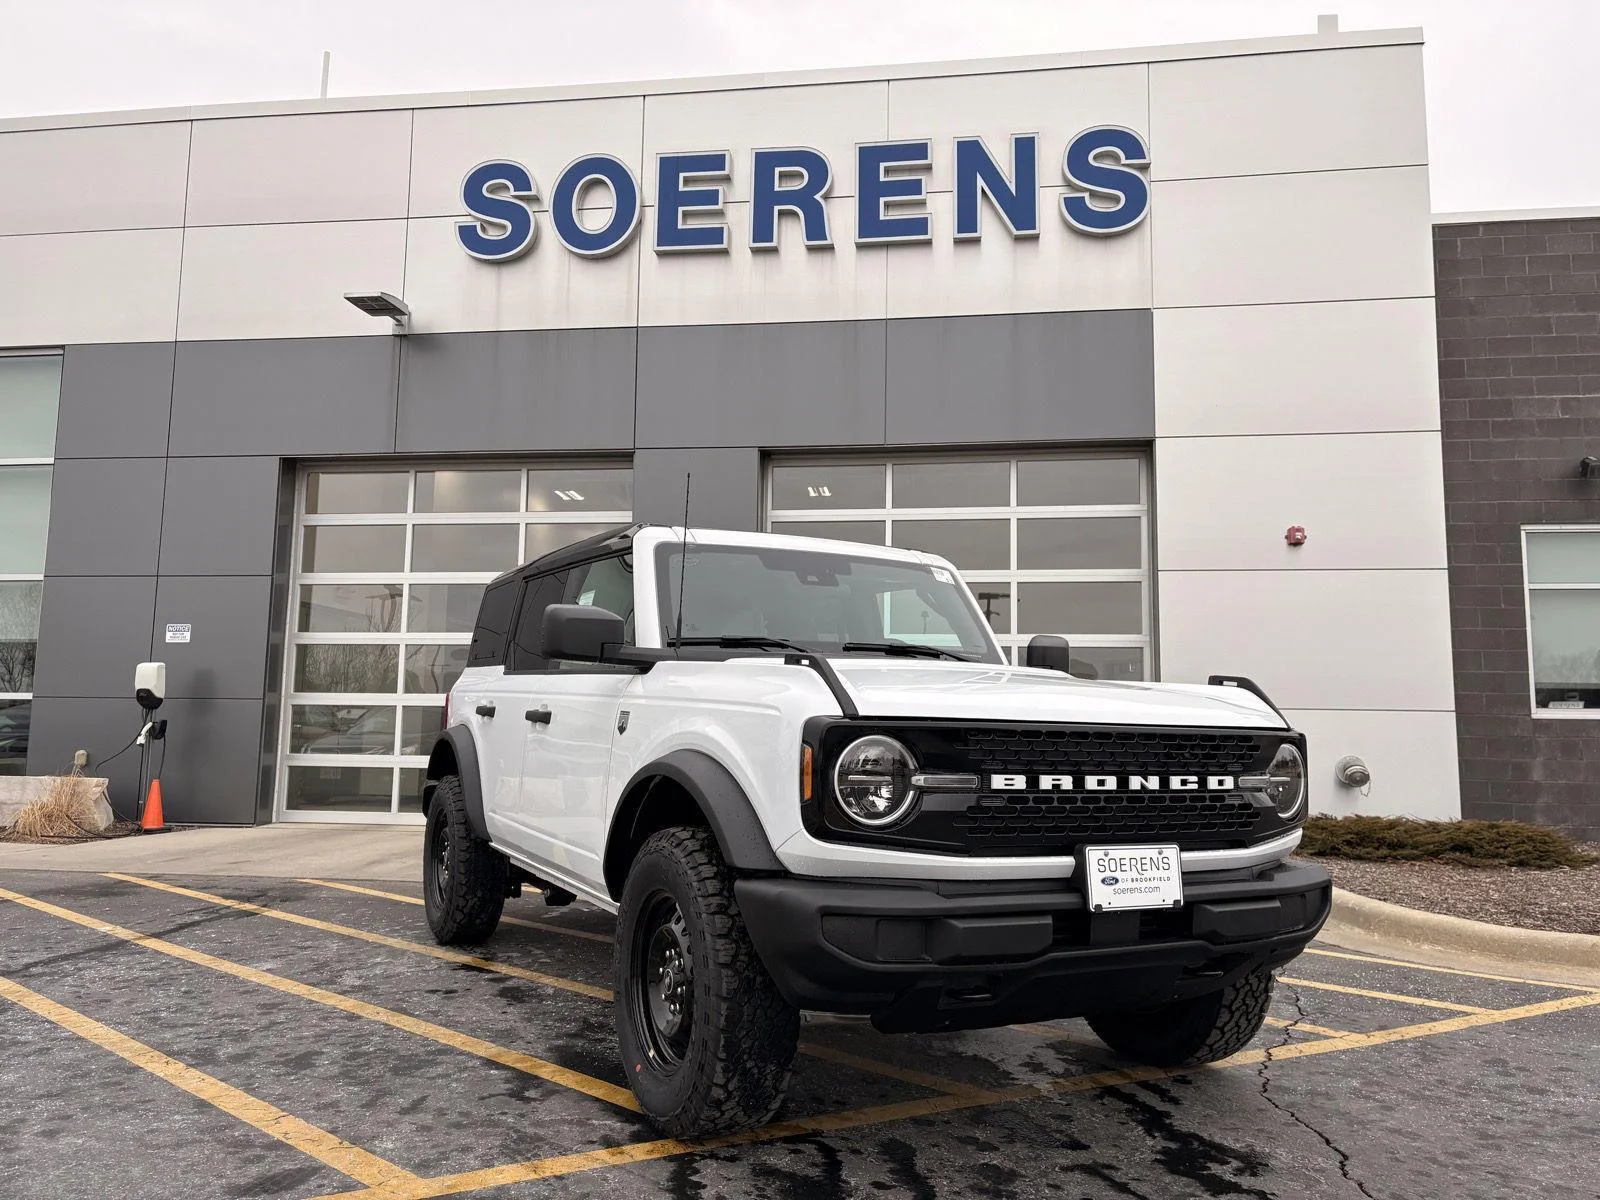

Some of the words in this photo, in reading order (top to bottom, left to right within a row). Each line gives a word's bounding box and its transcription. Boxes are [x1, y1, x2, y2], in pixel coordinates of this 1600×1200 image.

[455, 124, 1152, 264] SOERENS
[990, 774, 1235, 790] BRONCO
[1097, 856, 1171, 875] SOERENS
[1113, 885, 1160, 895] soerens.com
